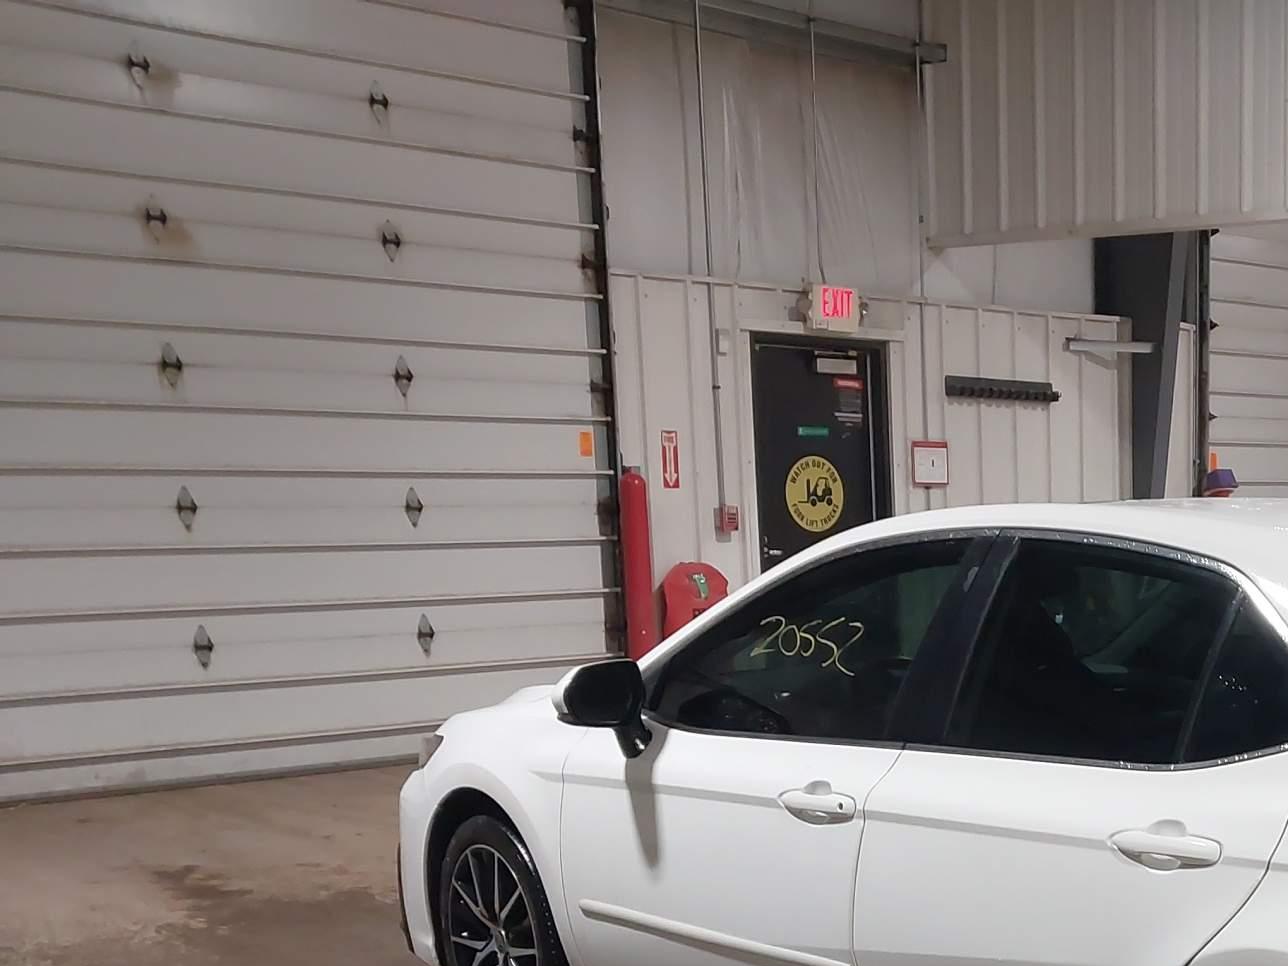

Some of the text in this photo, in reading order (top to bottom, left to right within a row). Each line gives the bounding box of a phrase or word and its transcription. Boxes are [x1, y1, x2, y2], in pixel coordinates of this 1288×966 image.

[822, 287, 853, 318] EXIT
[790, 460, 838, 484] WATCH OUT FOR
[750, 615, 864, 676] 20552
